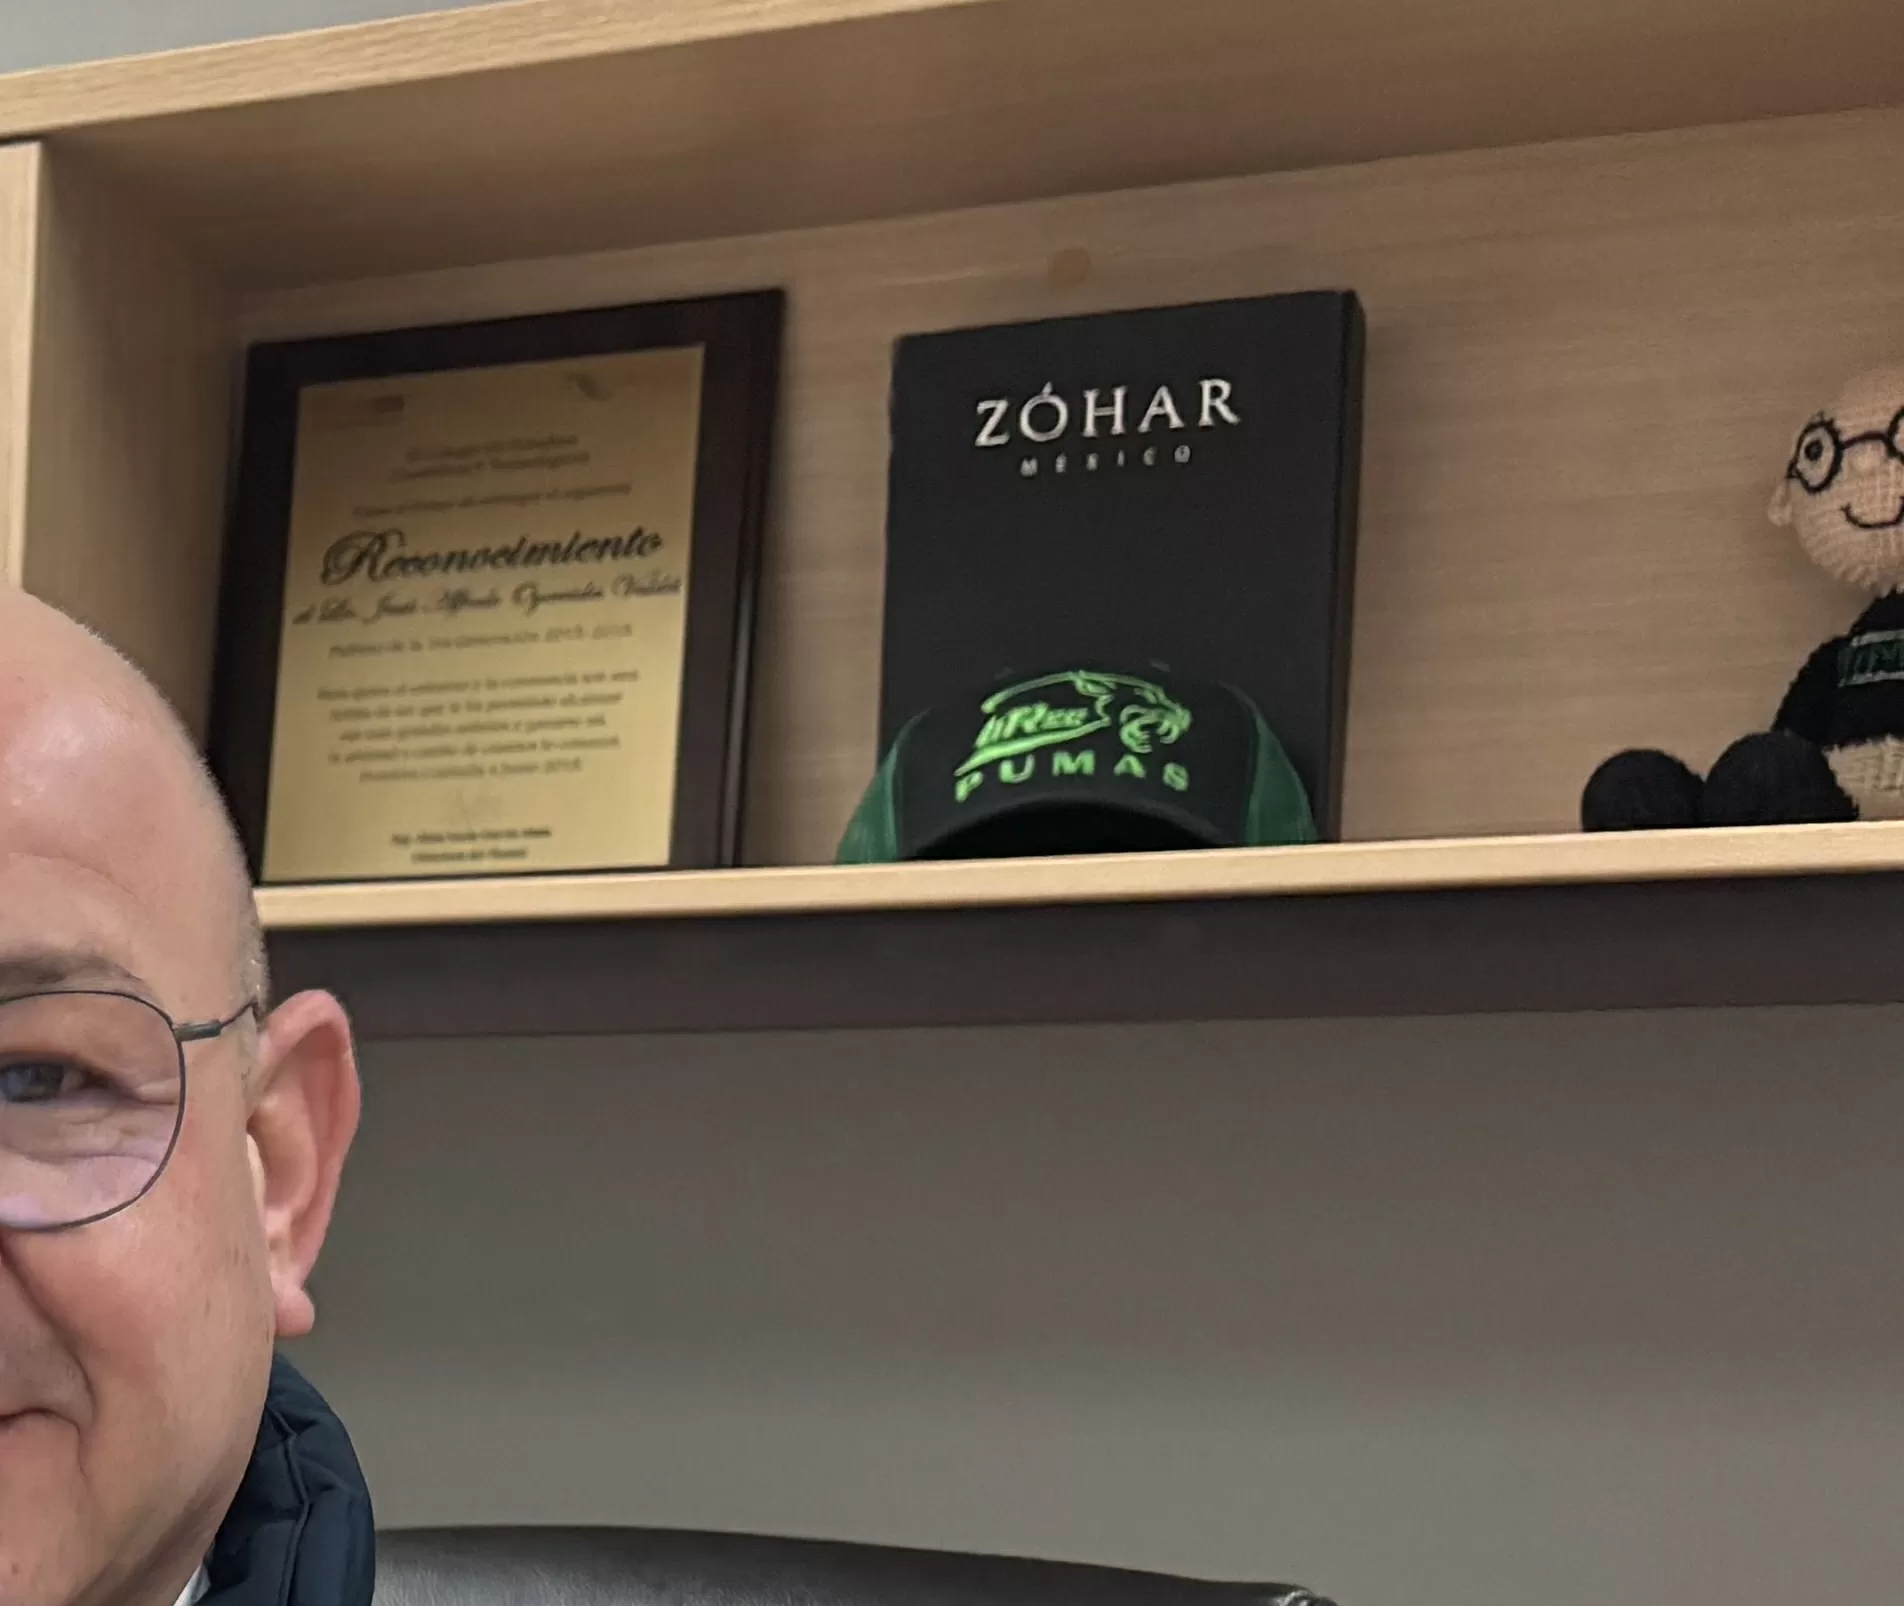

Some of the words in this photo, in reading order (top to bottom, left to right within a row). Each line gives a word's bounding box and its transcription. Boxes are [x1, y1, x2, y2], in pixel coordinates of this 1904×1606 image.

[975, 381, 1241, 447] ZÓHAR
[320, 526, 664, 585] Reconocimiento
[955, 749, 1190, 803] PUMAS
